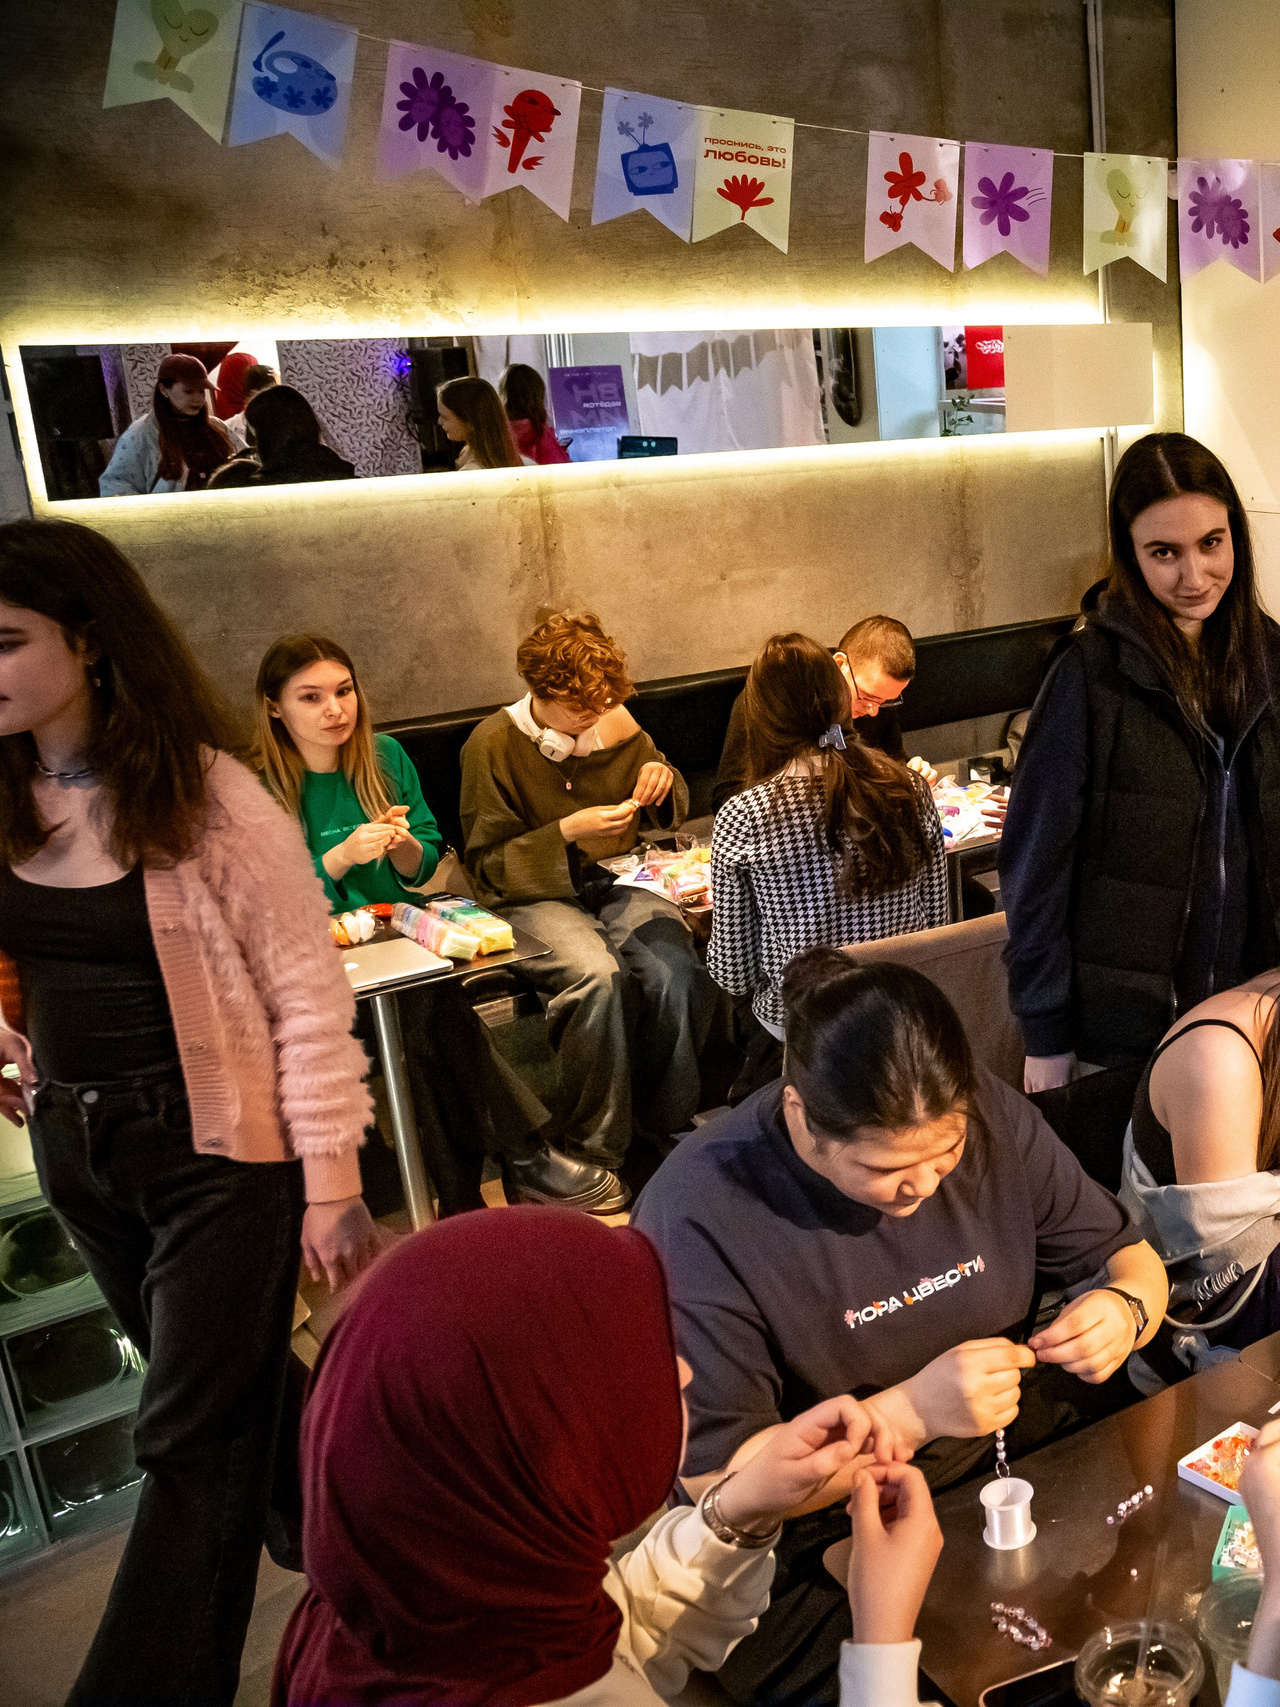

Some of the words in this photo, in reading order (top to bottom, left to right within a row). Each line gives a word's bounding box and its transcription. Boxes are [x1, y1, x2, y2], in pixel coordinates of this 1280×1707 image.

[704, 137, 764, 152] проснись,
[766, 145, 787, 154] это
[845, 1296, 903, 1329] ПОРА
[903, 1255, 985, 1306] ЦВЕСТИ
